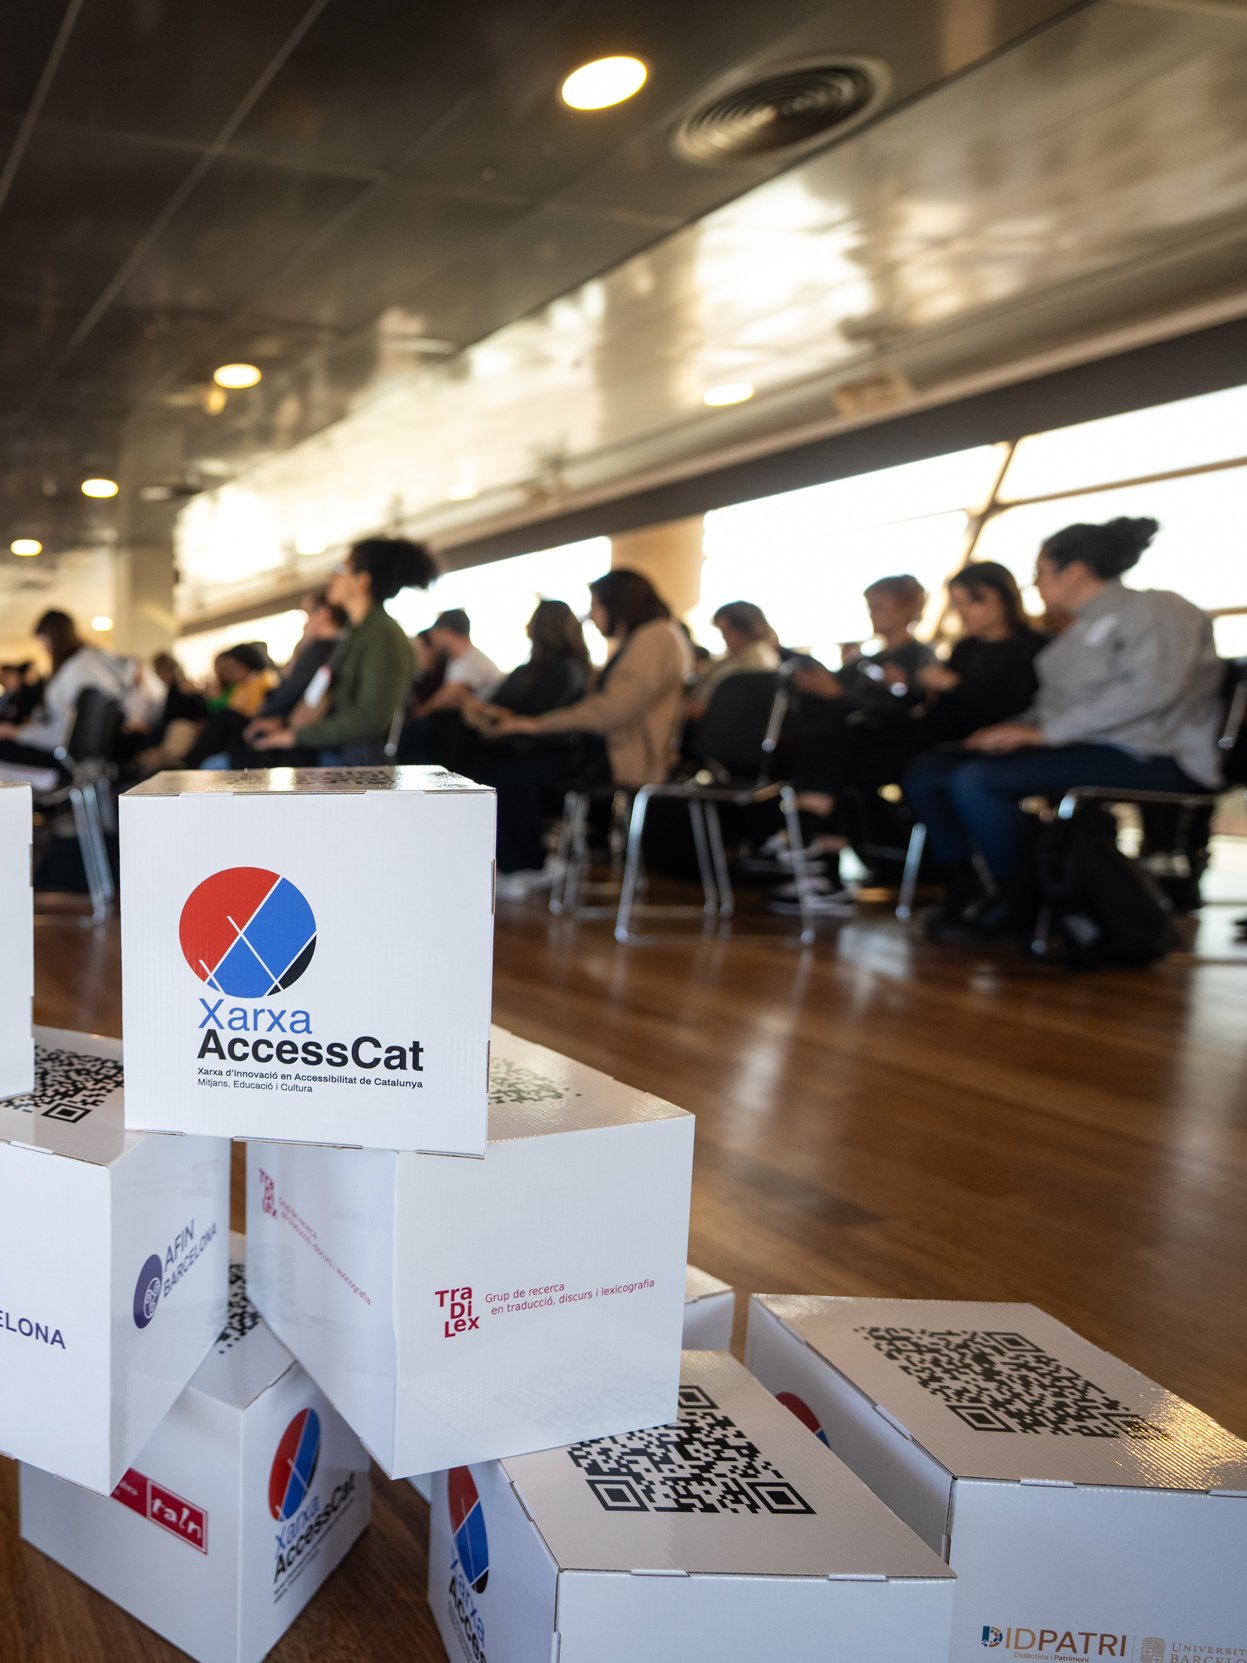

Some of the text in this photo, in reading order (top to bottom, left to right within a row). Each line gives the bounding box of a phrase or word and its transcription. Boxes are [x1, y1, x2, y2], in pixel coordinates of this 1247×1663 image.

[198, 998, 312, 1034] Xarxa
[197, 1029, 424, 1072] AccessCat
[197, 1067, 423, 1089] Xarxa d'Innovació en Accessibilitat de Catalunya
[197, 1078, 230, 1089] Mitjans,
[233, 1080, 274, 1091] Educació
[280, 1083, 313, 1093] Cultura
[164, 1218, 194, 1273] AFIN
[163, 1222, 217, 1298] BARCELONA
[435, 1286, 473, 1308] Tra
[485, 1282, 565, 1304] Grup de recerca
[491, 1279, 655, 1315] en traducció, discurs i lexicografia
[450, 1301, 473, 1320] Di
[444, 1316, 480, 1338] Lex
[1014, 1651, 1049, 1661] Didàctica
[1054, 1654, 1090, 1663] Patrimoni
[1172, 1642, 1247, 1656] UNIVERSIT
